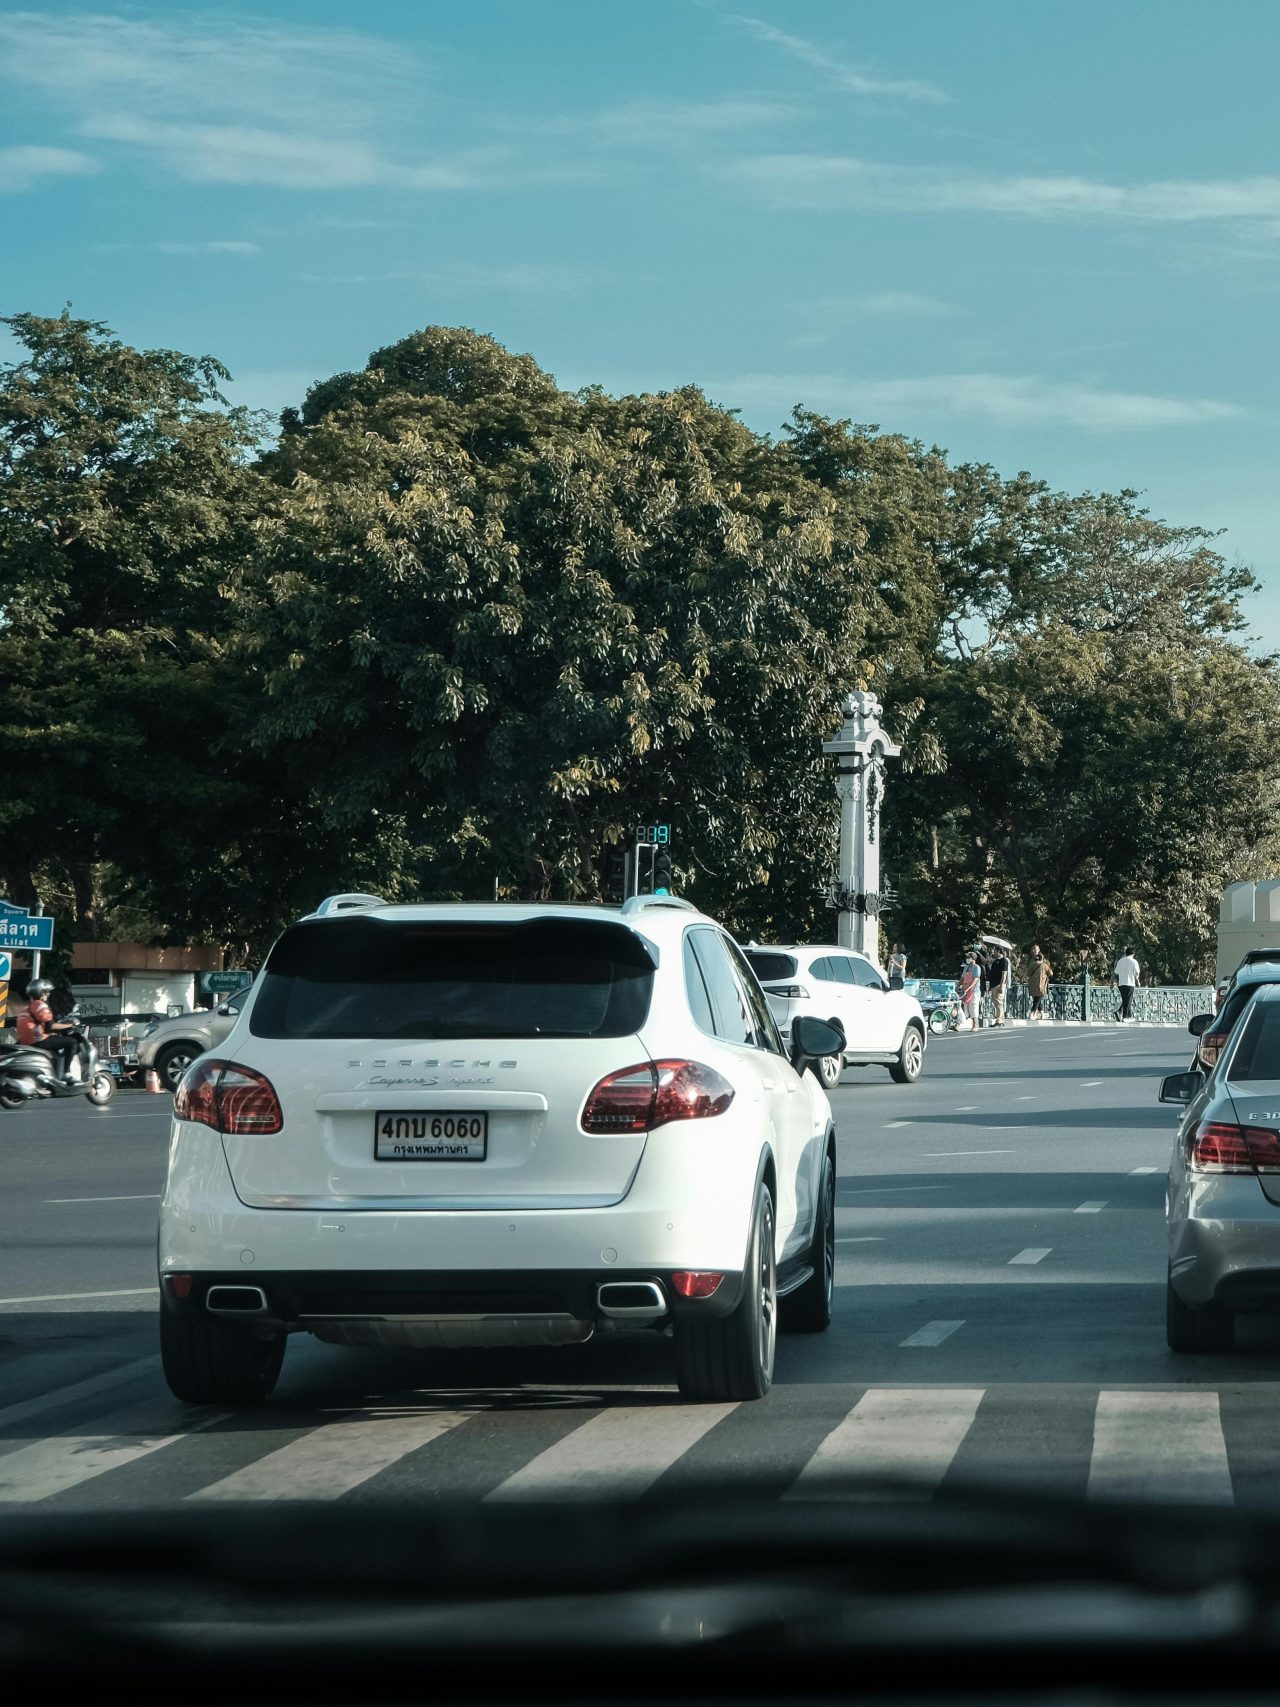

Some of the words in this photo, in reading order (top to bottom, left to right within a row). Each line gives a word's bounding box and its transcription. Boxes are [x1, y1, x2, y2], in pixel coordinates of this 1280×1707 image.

[4, 938, 28, 946] Lilat
[347, 1059, 518, 1069] PORSCHE
[1248, 1112, 1258, 1120] E
[431, 1118, 482, 1138] 6060
[393, 1145, 469, 1157] กรุงเทพมหานคร
